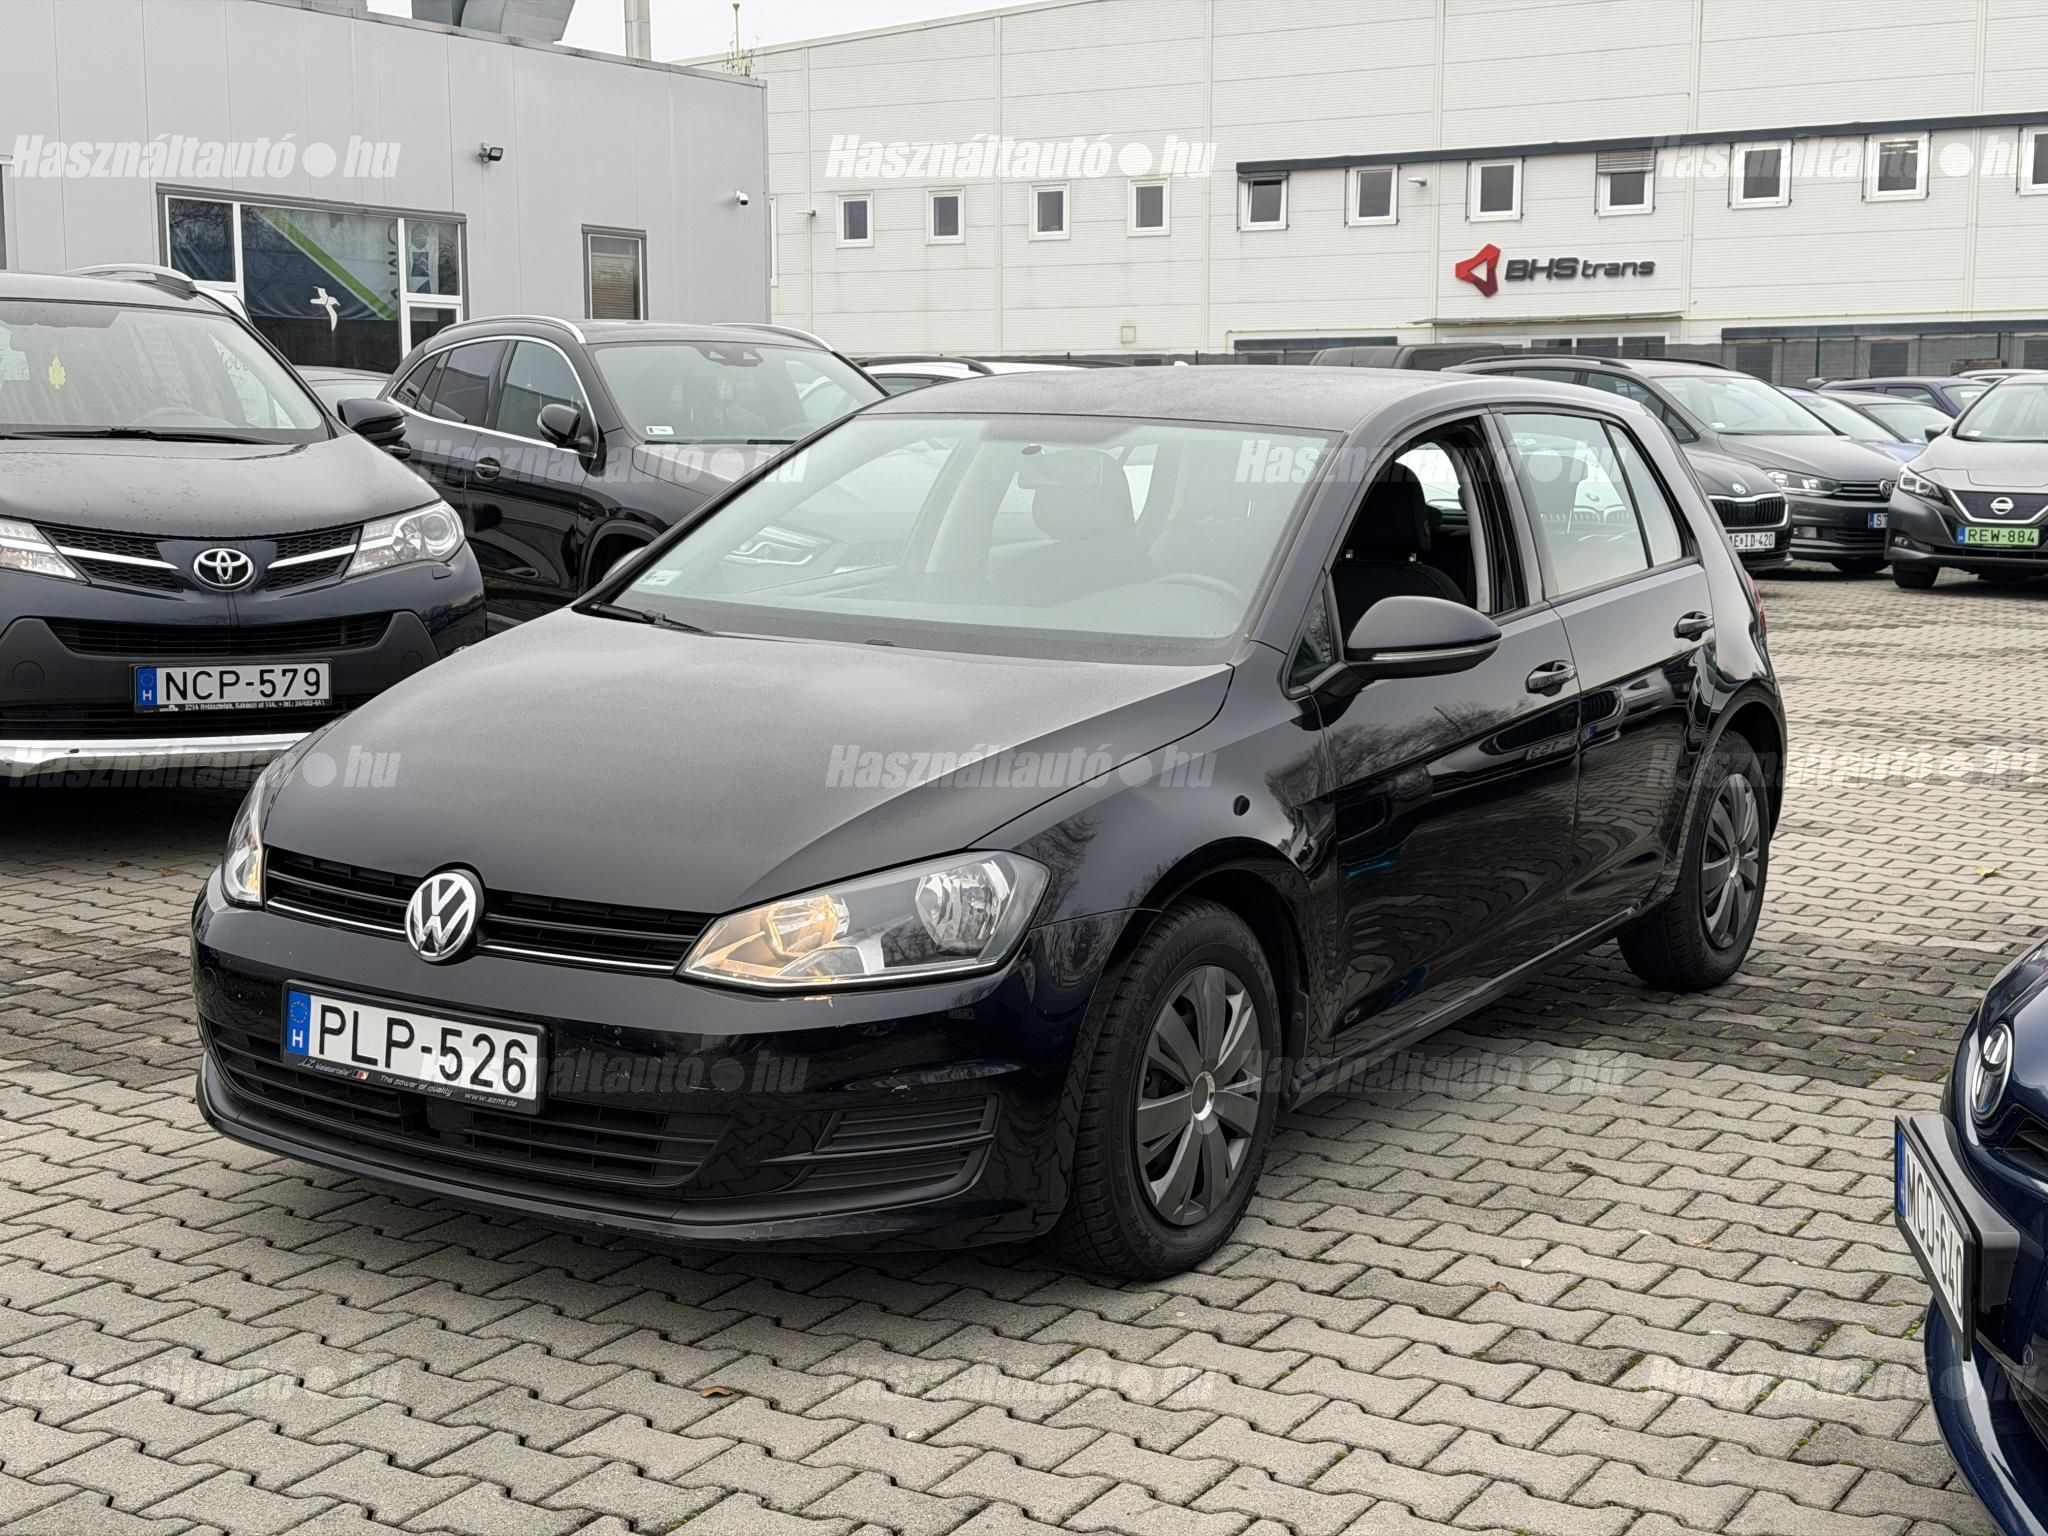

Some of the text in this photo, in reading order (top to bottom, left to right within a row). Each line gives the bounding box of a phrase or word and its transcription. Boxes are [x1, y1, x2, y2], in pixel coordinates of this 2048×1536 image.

[1504, 257, 1656, 281] BHS trans
[1968, 528, 2036, 544] REW-884
[165, 667, 321, 701] NCP-579
[292, 1003, 528, 1094] H PLP-526
[381, 1074, 393, 1084] The
[394, 1078, 417, 1088] power
[428, 1085, 453, 1097] quality
[1907, 1152, 1964, 1318] MCD-640
